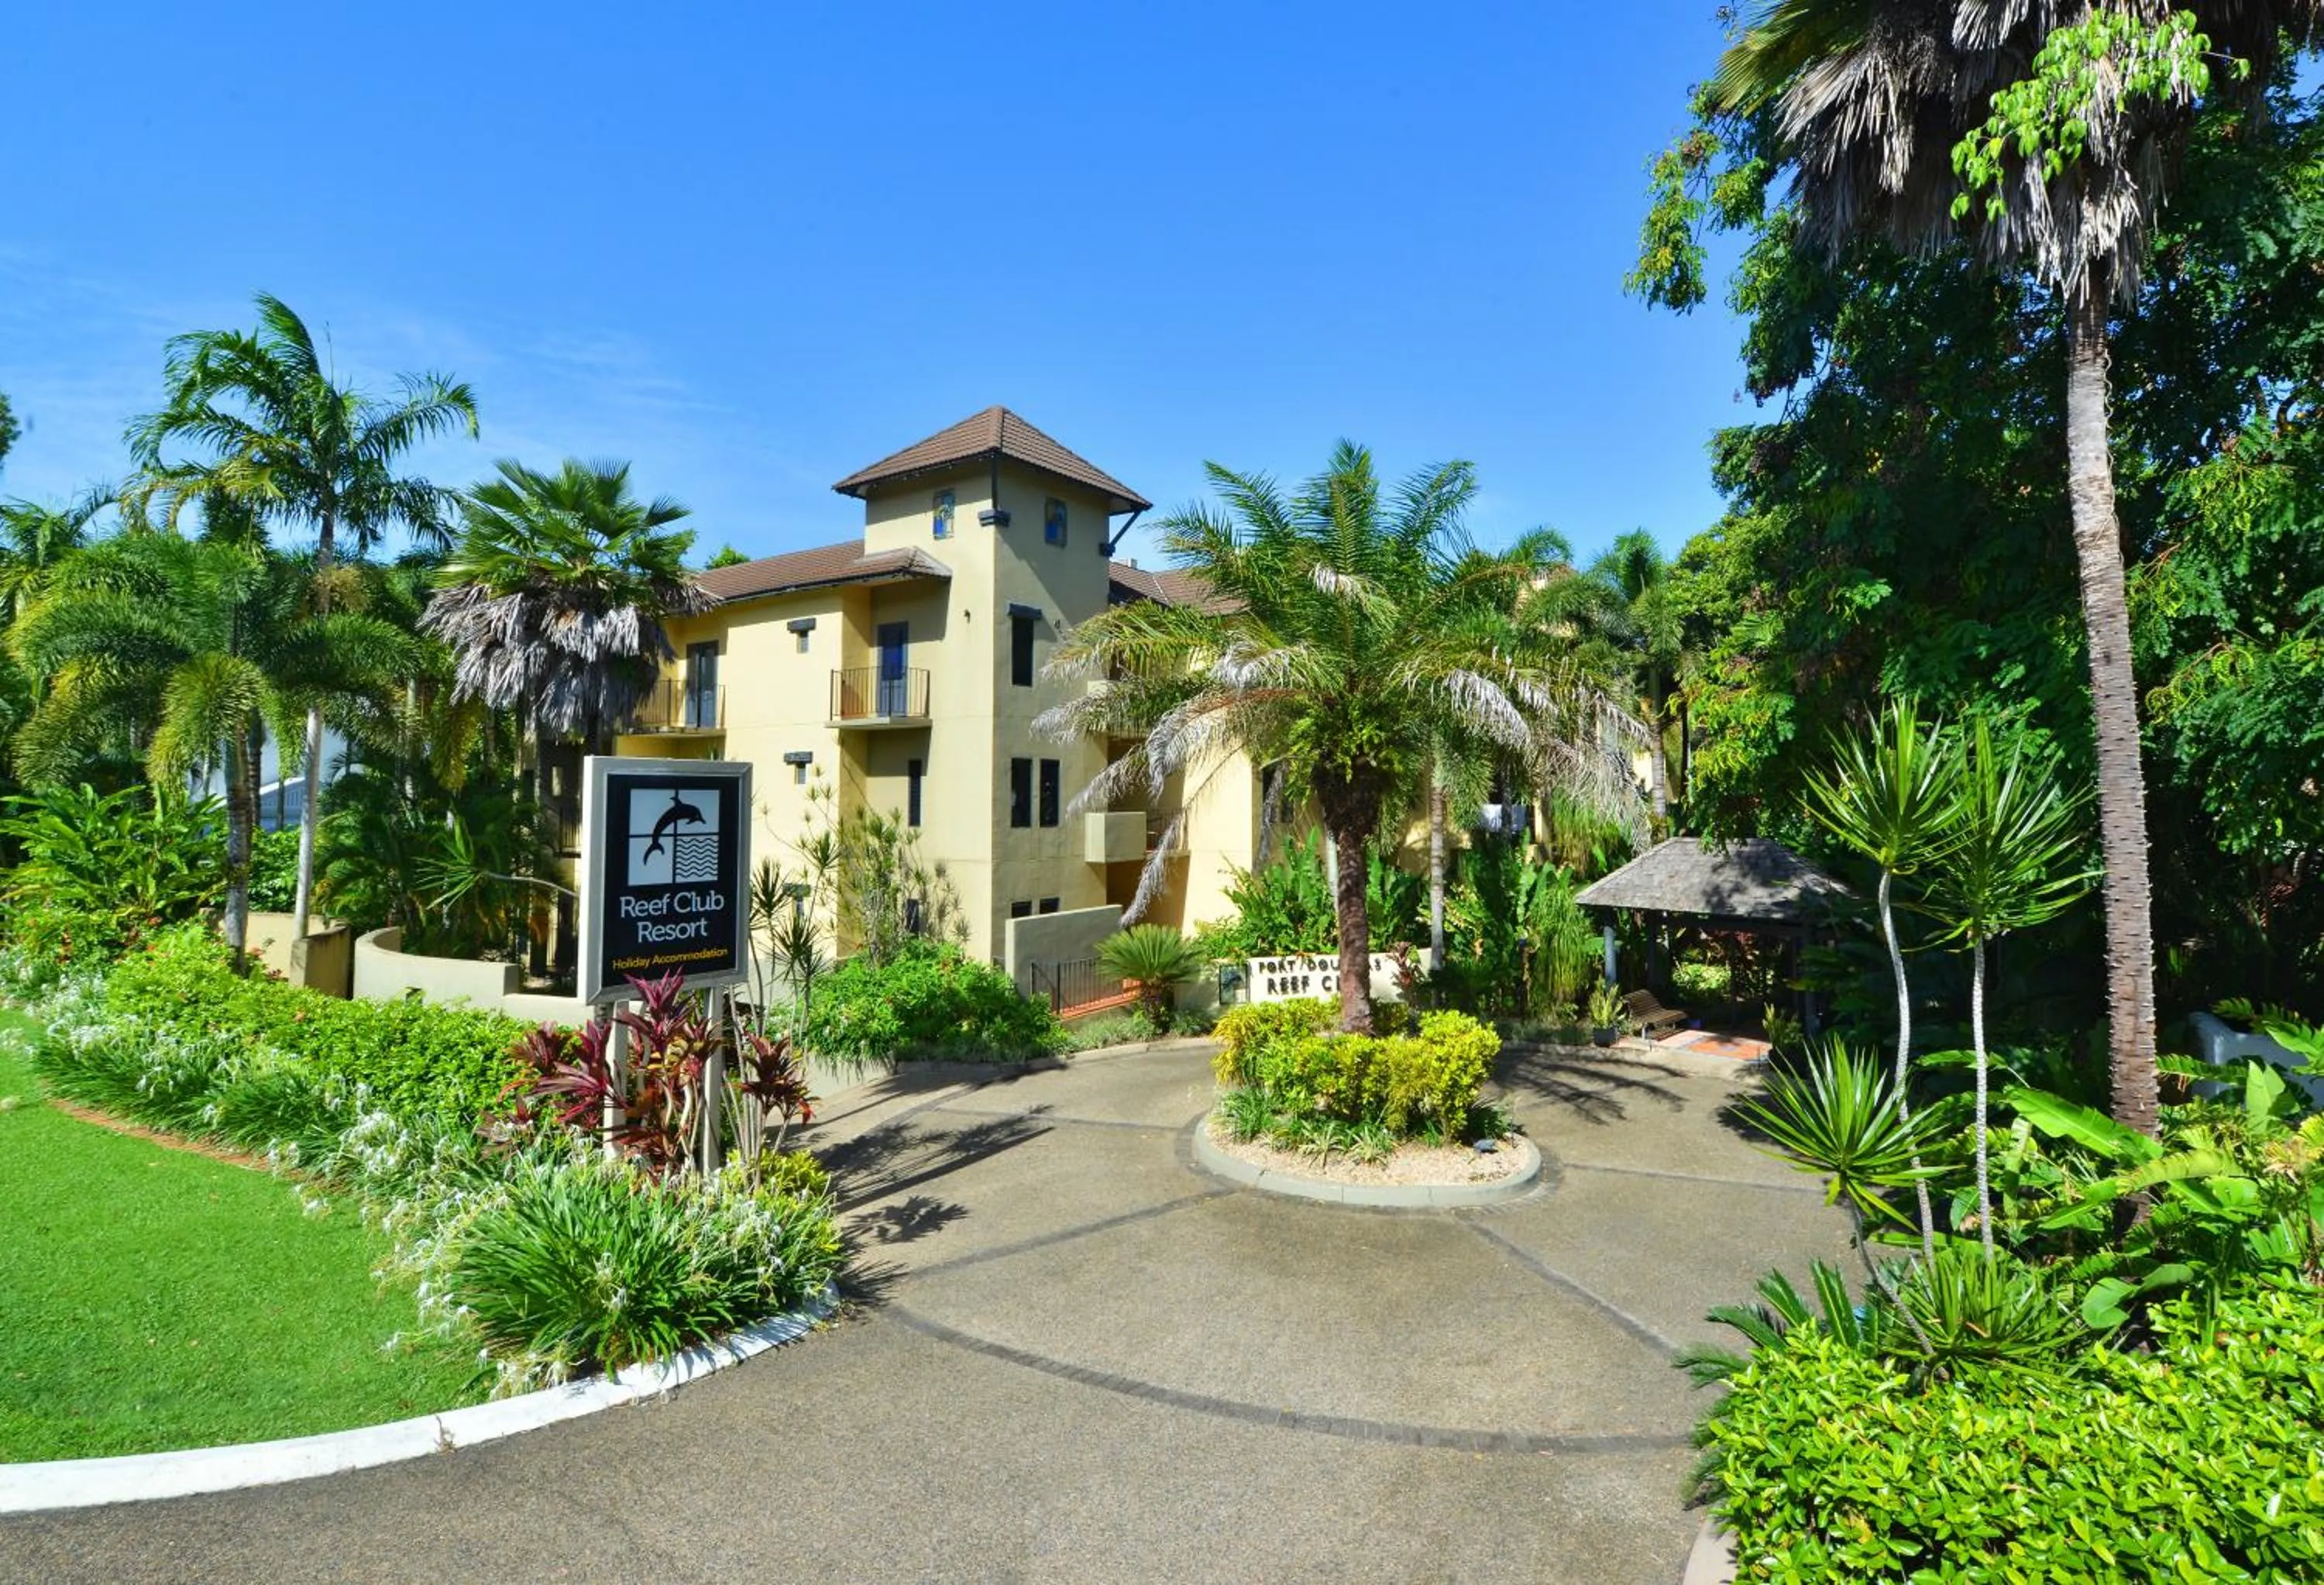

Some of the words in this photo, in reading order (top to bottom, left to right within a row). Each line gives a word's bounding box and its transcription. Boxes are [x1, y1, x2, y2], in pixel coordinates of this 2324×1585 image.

[620, 893, 671, 918] Reef
[673, 889, 724, 913] Club
[637, 916, 708, 943] Resort
[612, 955, 650, 970] Holiday
[652, 947, 727, 965] Accommodation
[1258, 960, 1296, 974] PORT
[1267, 975, 1310, 995] REEF
